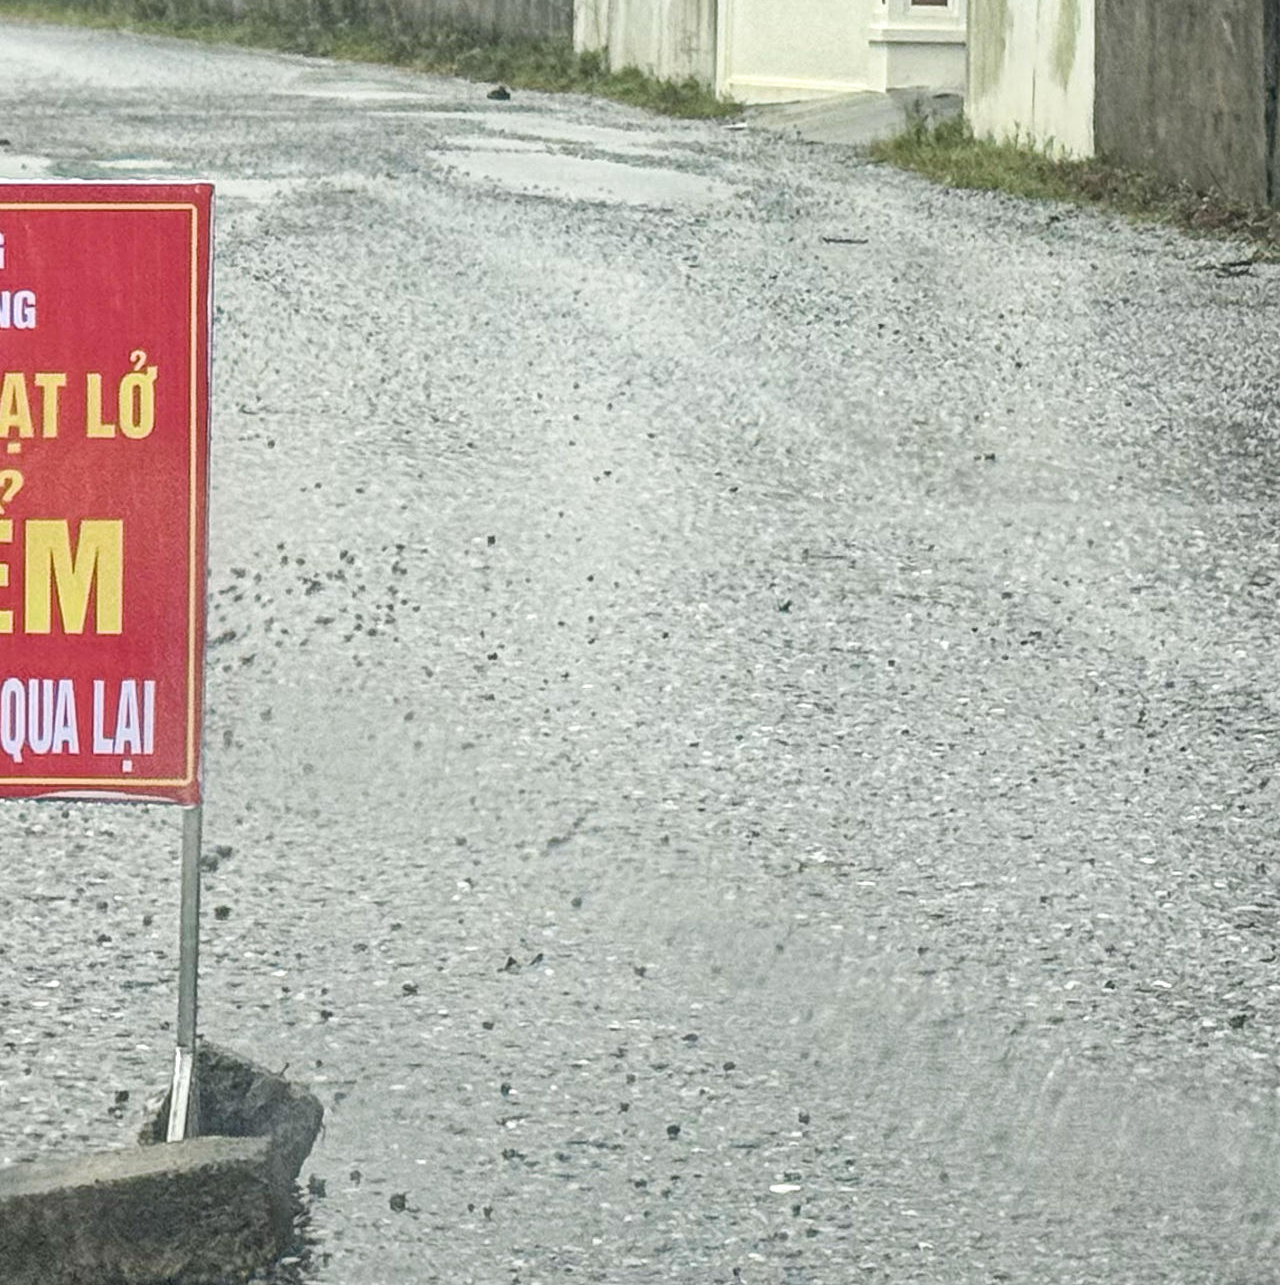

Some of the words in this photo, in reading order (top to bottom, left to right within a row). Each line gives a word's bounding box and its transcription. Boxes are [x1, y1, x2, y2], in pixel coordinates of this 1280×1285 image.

[86, 349, 158, 440] LỞ
[0, 677, 80, 760] QUA
[92, 678, 157, 773] LẠI
